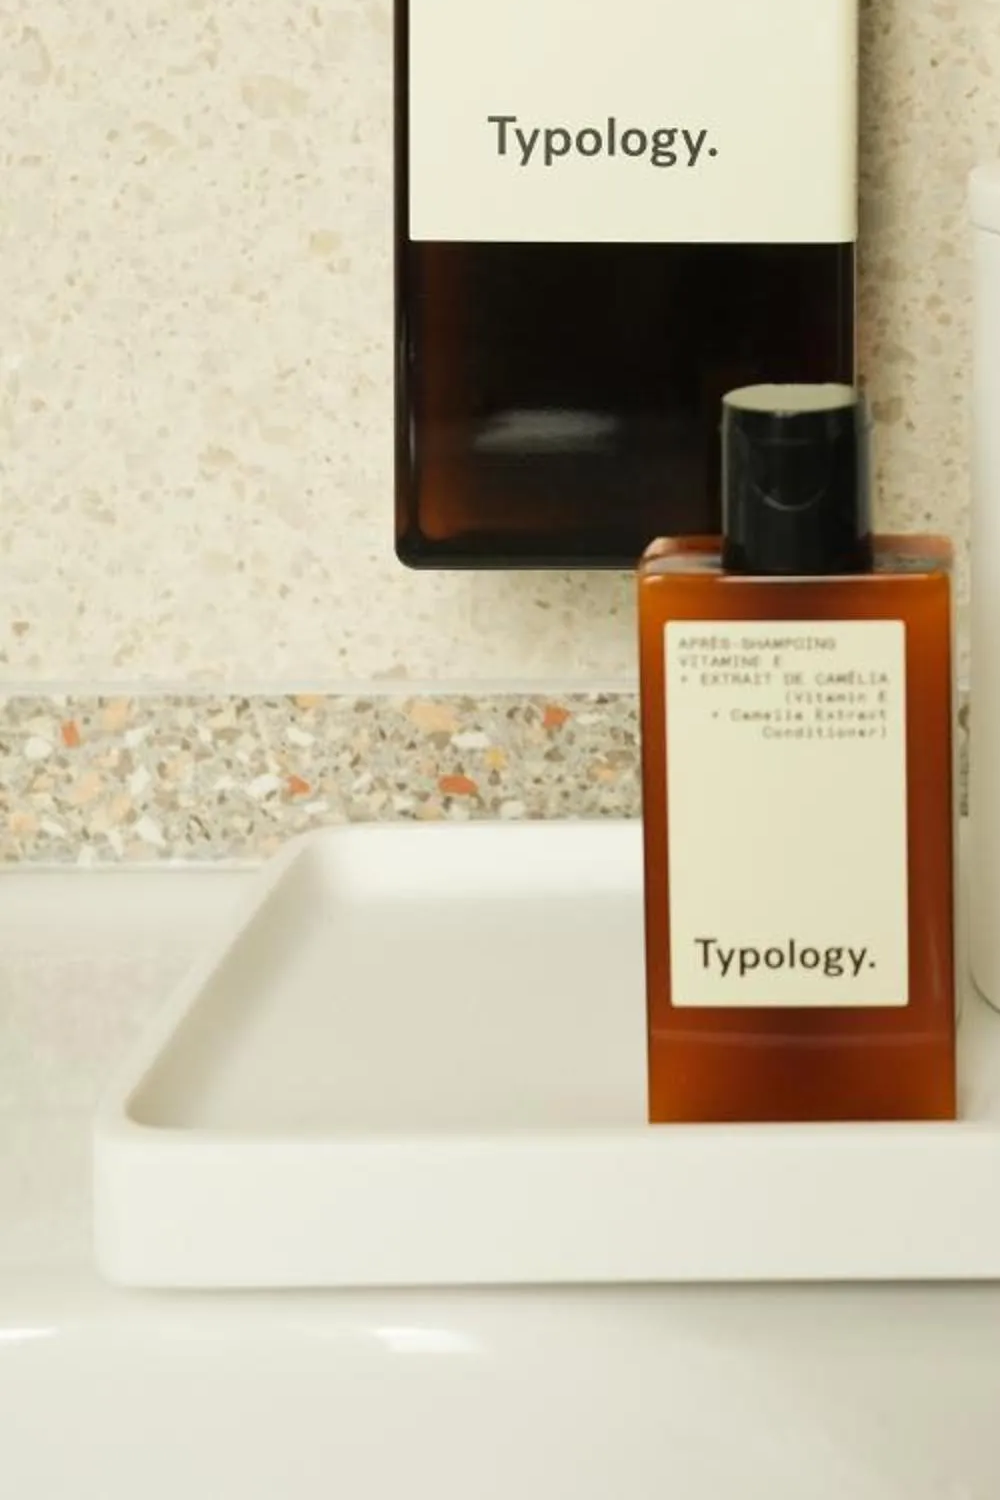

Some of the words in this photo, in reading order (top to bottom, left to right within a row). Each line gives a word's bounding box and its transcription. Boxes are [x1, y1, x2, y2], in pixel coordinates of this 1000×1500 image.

[487, 116, 718, 167] Typology.
[678, 655, 760, 668] VITAMINE
[700, 673, 772, 686] EXTRAIT
[784, 673, 802, 685] DE
[695, 938, 876, 977] Typology.
